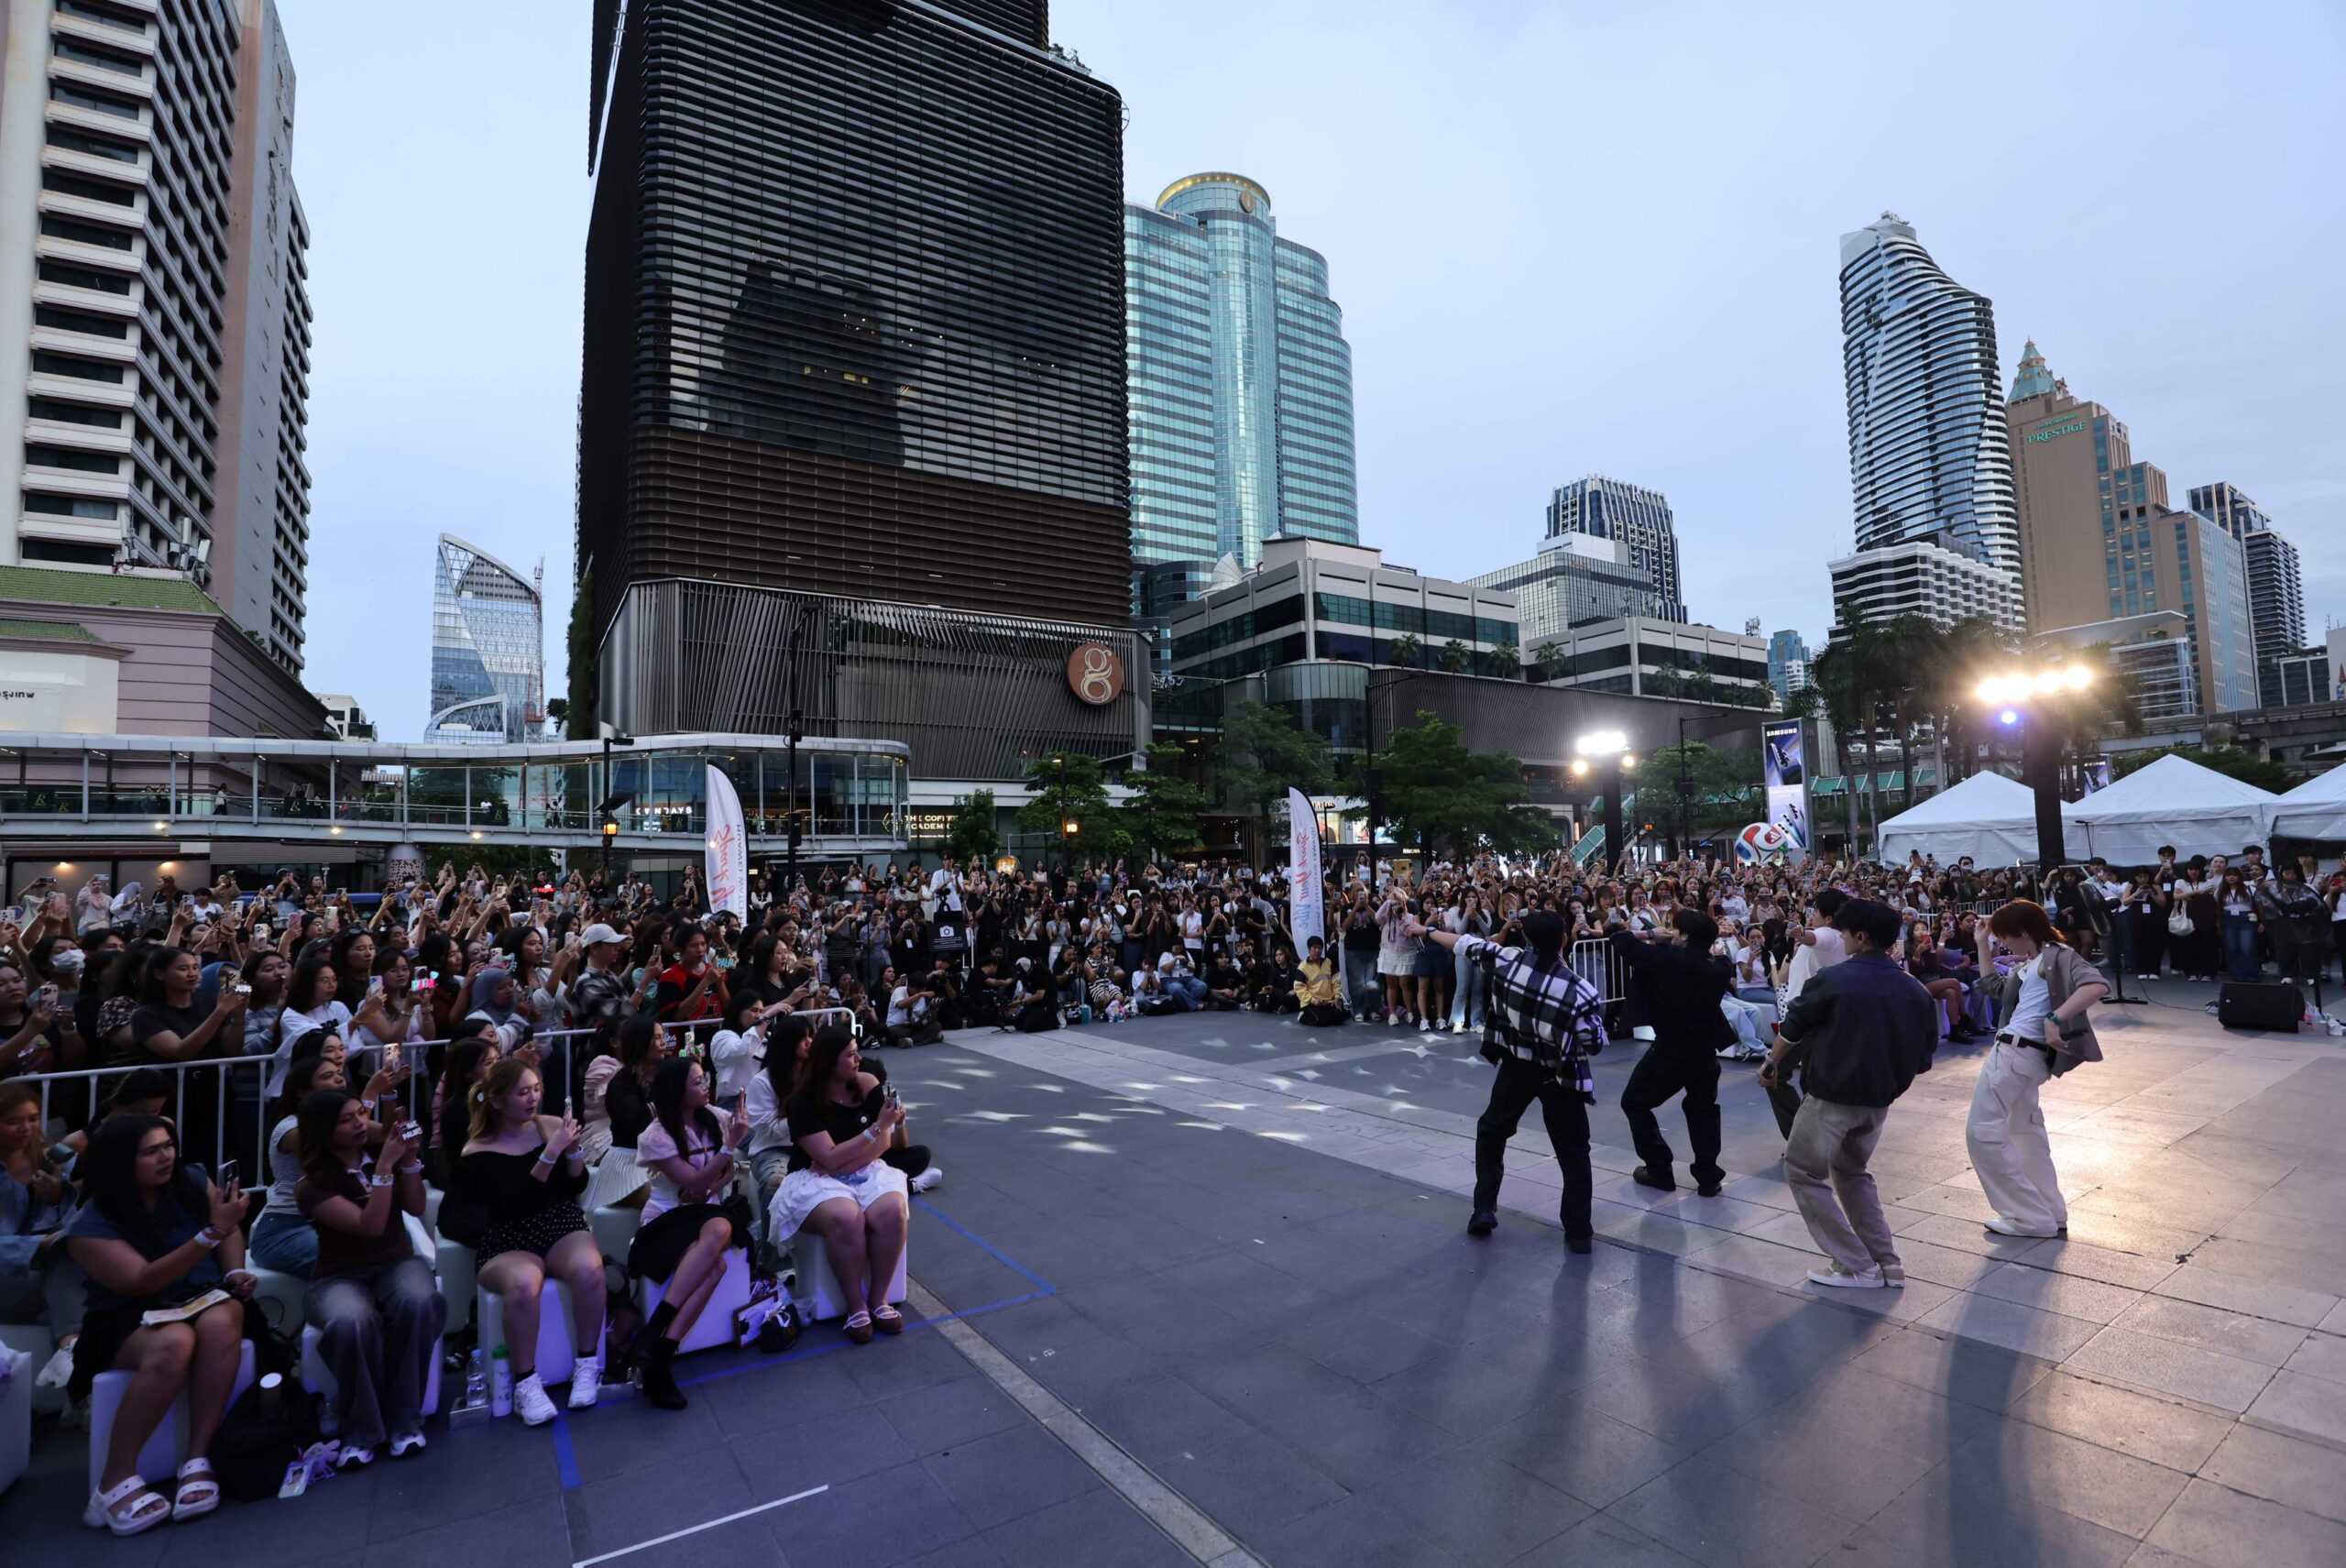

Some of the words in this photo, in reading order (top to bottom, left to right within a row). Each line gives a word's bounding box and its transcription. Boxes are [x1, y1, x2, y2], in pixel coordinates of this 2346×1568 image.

[2027, 421, 2087, 444] PRESTIGE
[1080, 647, 1113, 704] g
[1766, 728, 1798, 737] SAMSUNG
